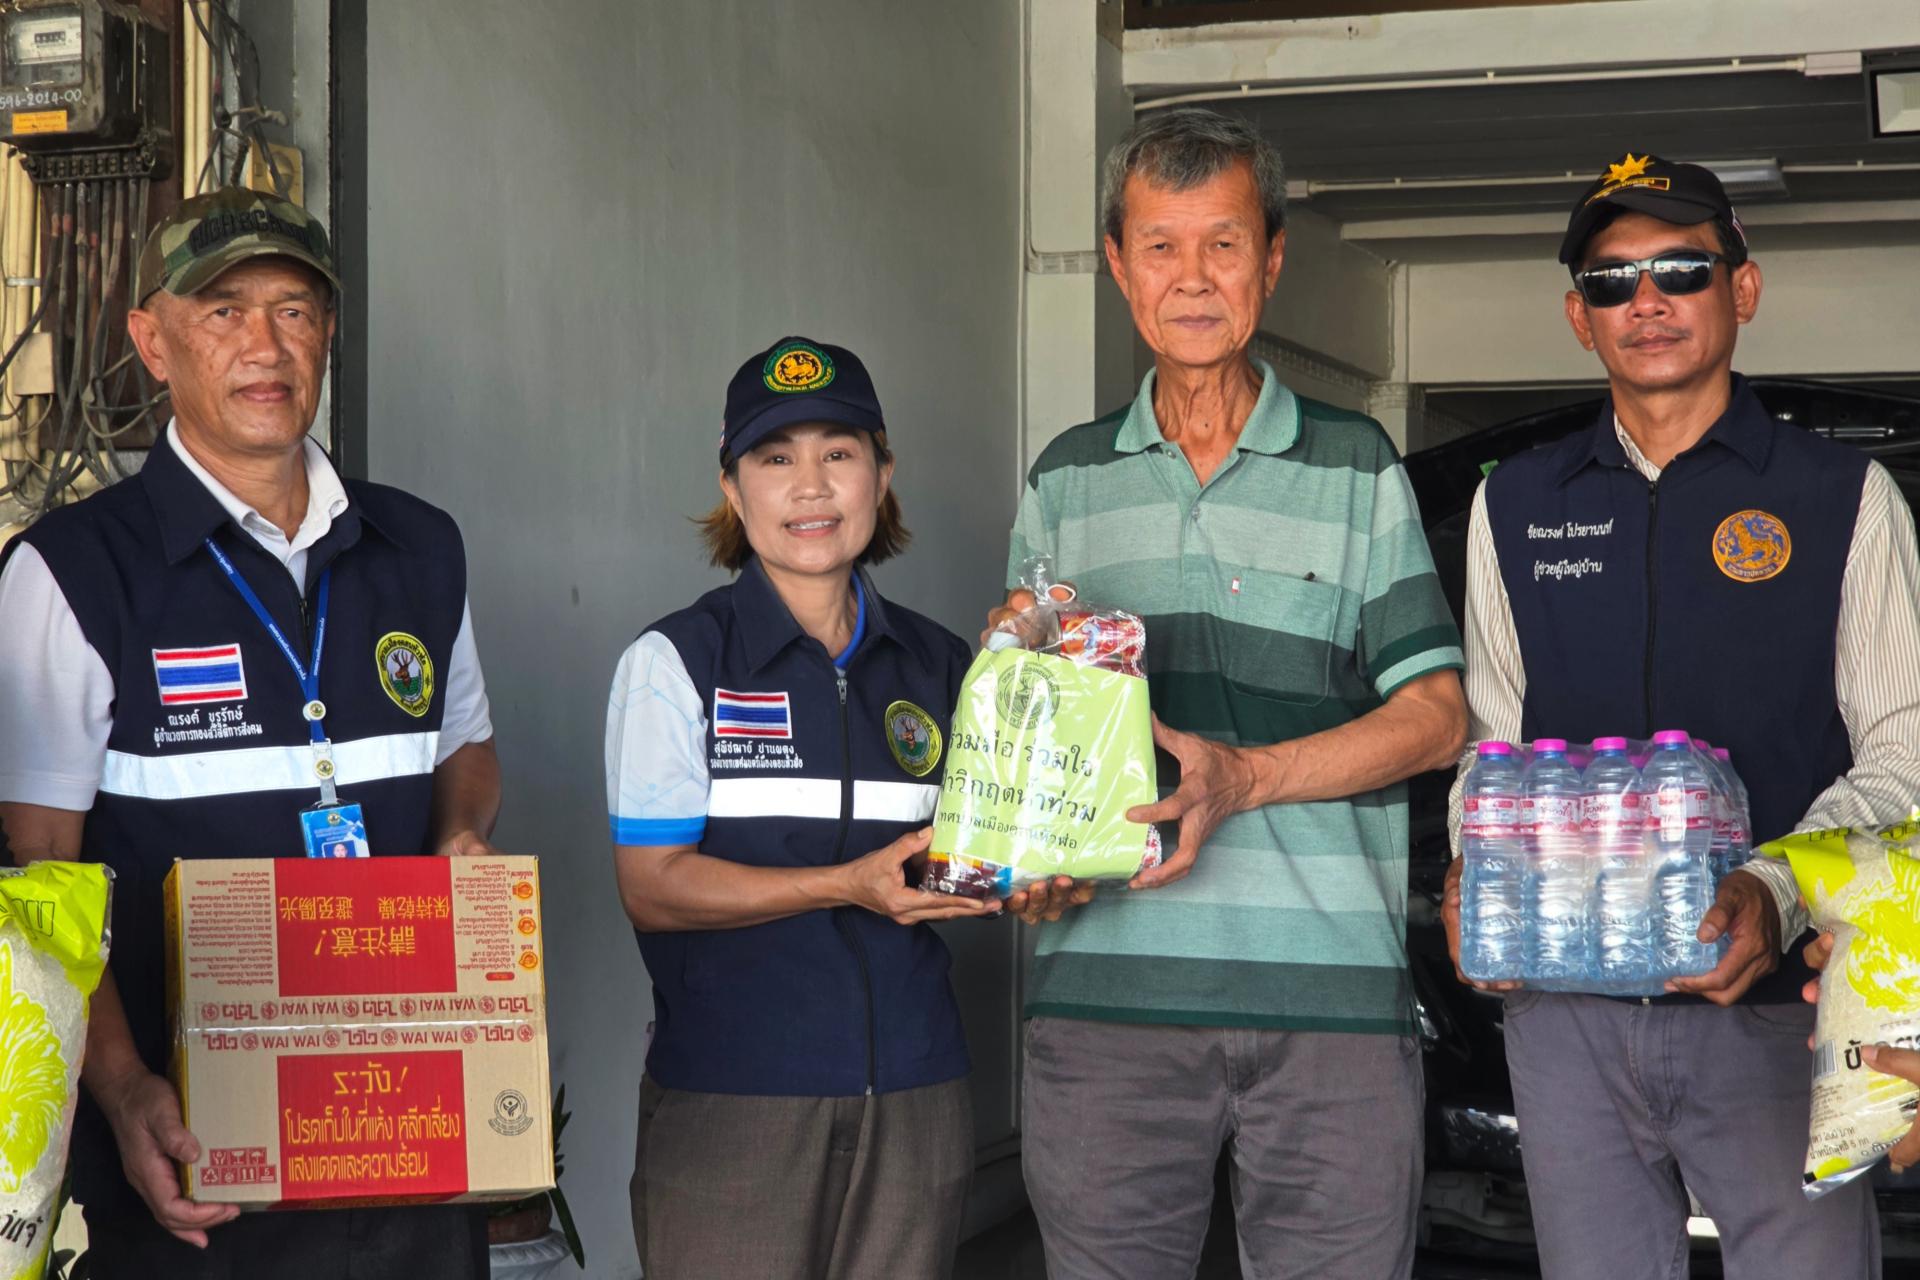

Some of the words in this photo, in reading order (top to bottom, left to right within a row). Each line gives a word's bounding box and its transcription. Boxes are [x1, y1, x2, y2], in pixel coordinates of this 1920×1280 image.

[167, 708, 200, 726] ณรงค์
[279, 895, 353, 921] 避免陽光
[378, 895, 450, 920] 保持乾燥
[282, 1002, 308, 1015] WAI
[313, 1001, 339, 1014] WAI
[420, 1000, 446, 1012] WAI
[450, 999, 476, 1010] WAI
[202, 1033, 238, 1050] ไวไว
[262, 1036, 289, 1049] WAI
[293, 1034, 320, 1048] WAI
[342, 1029, 378, 1046] ไวไว
[401, 1032, 427, 1044] WAI
[432, 1031, 458, 1043] WAI
[480, 1025, 515, 1042] ไวไว
[285, 1097, 393, 1145] โปรดเก็บในที่แห้ง
[397, 1094, 460, 1141] หลีกเลี่ยง
[288, 1142, 429, 1182] แสงแดดและความร้อน
